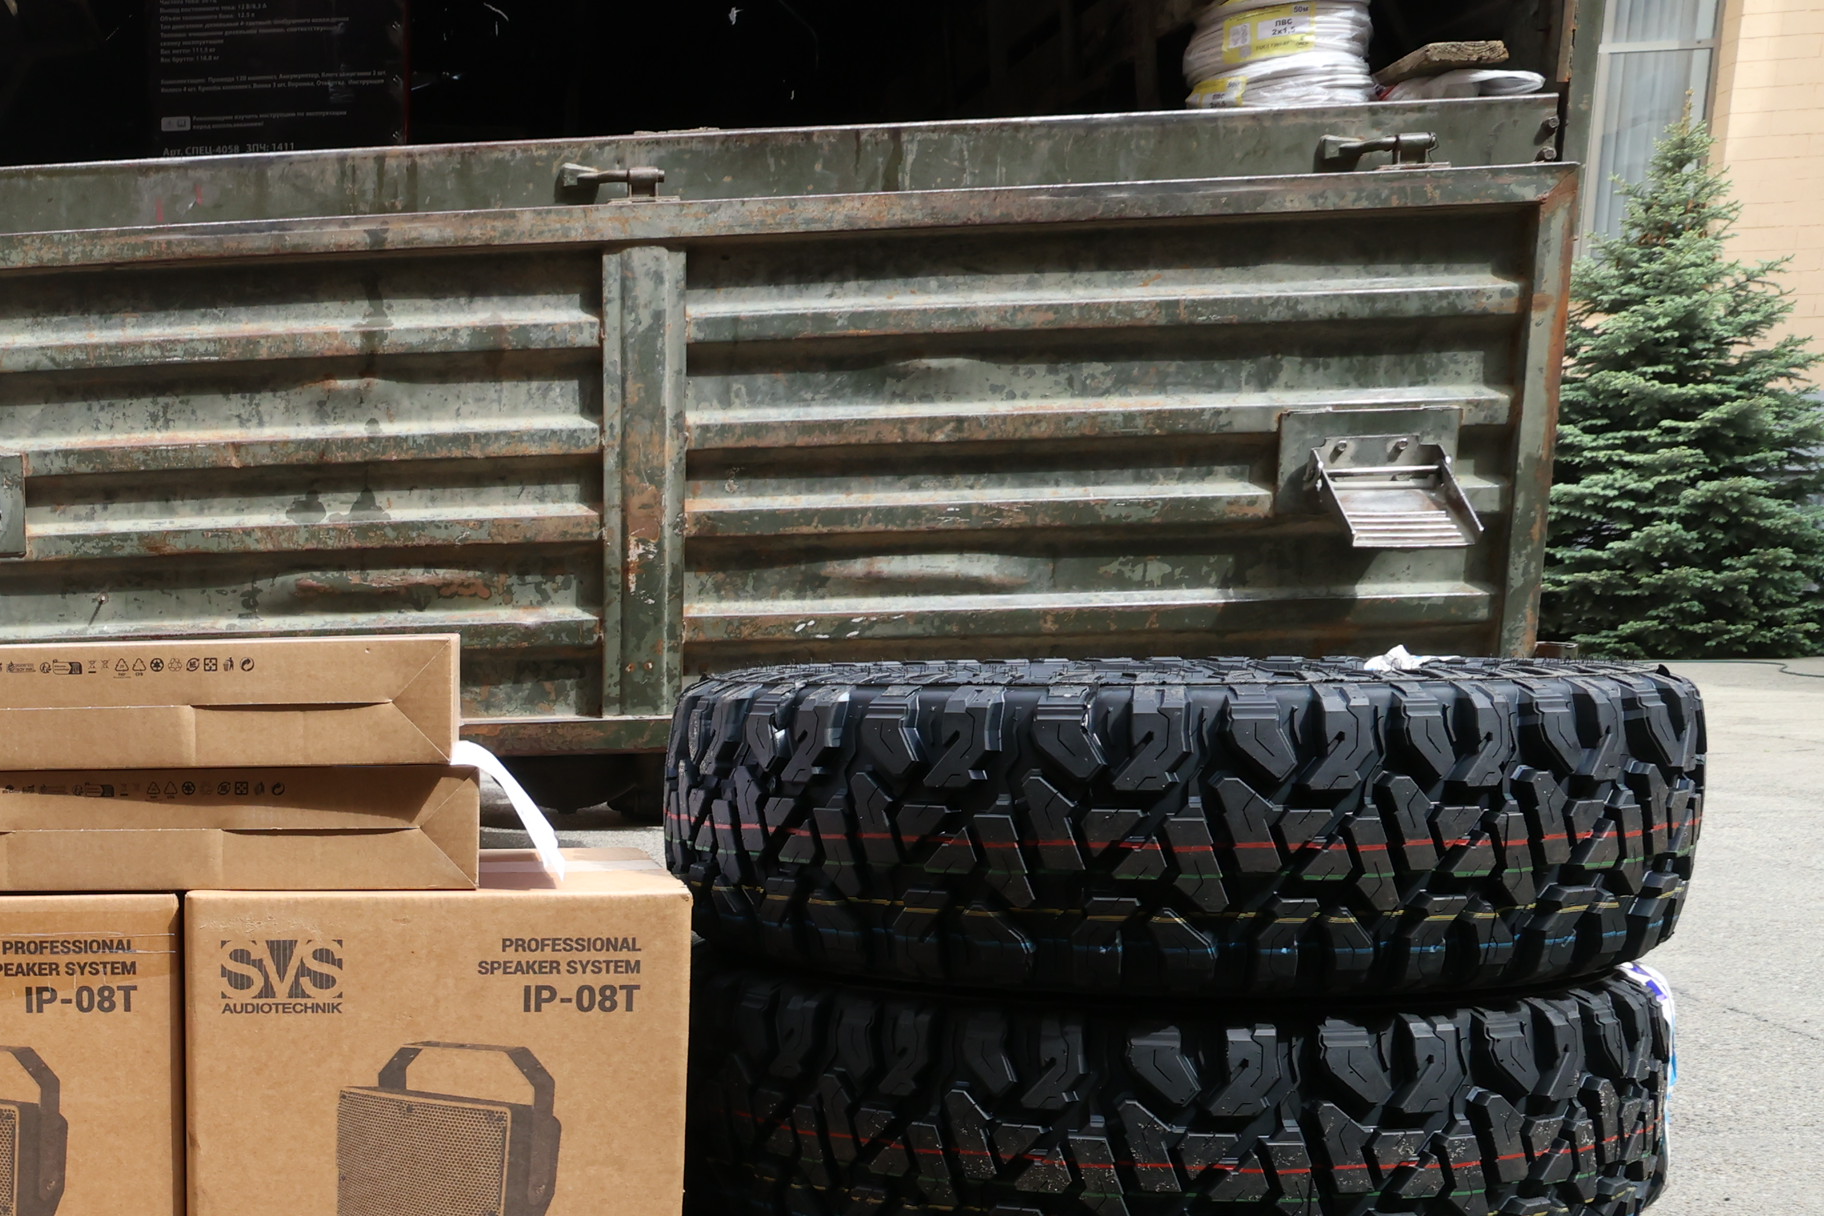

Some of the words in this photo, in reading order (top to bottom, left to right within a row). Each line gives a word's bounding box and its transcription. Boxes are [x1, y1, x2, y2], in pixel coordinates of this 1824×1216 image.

[1275, 18, 1293, 27] ПВС
[272, 142, 295, 152] 1411
[1, 939, 137, 956] PROFESSIONAL
[501, 937, 641, 953] PROFESSIONAL
[64, 960, 137, 977] SYSTEM
[220, 939, 343, 999] SVS
[477, 960, 561, 976] SPEAKER
[566, 959, 641, 975] SYSTEM
[24, 985, 138, 1014] IP-08T
[523, 984, 640, 1013] IP-08T
[221, 1002, 343, 1015] AUDIOTECHNIK
